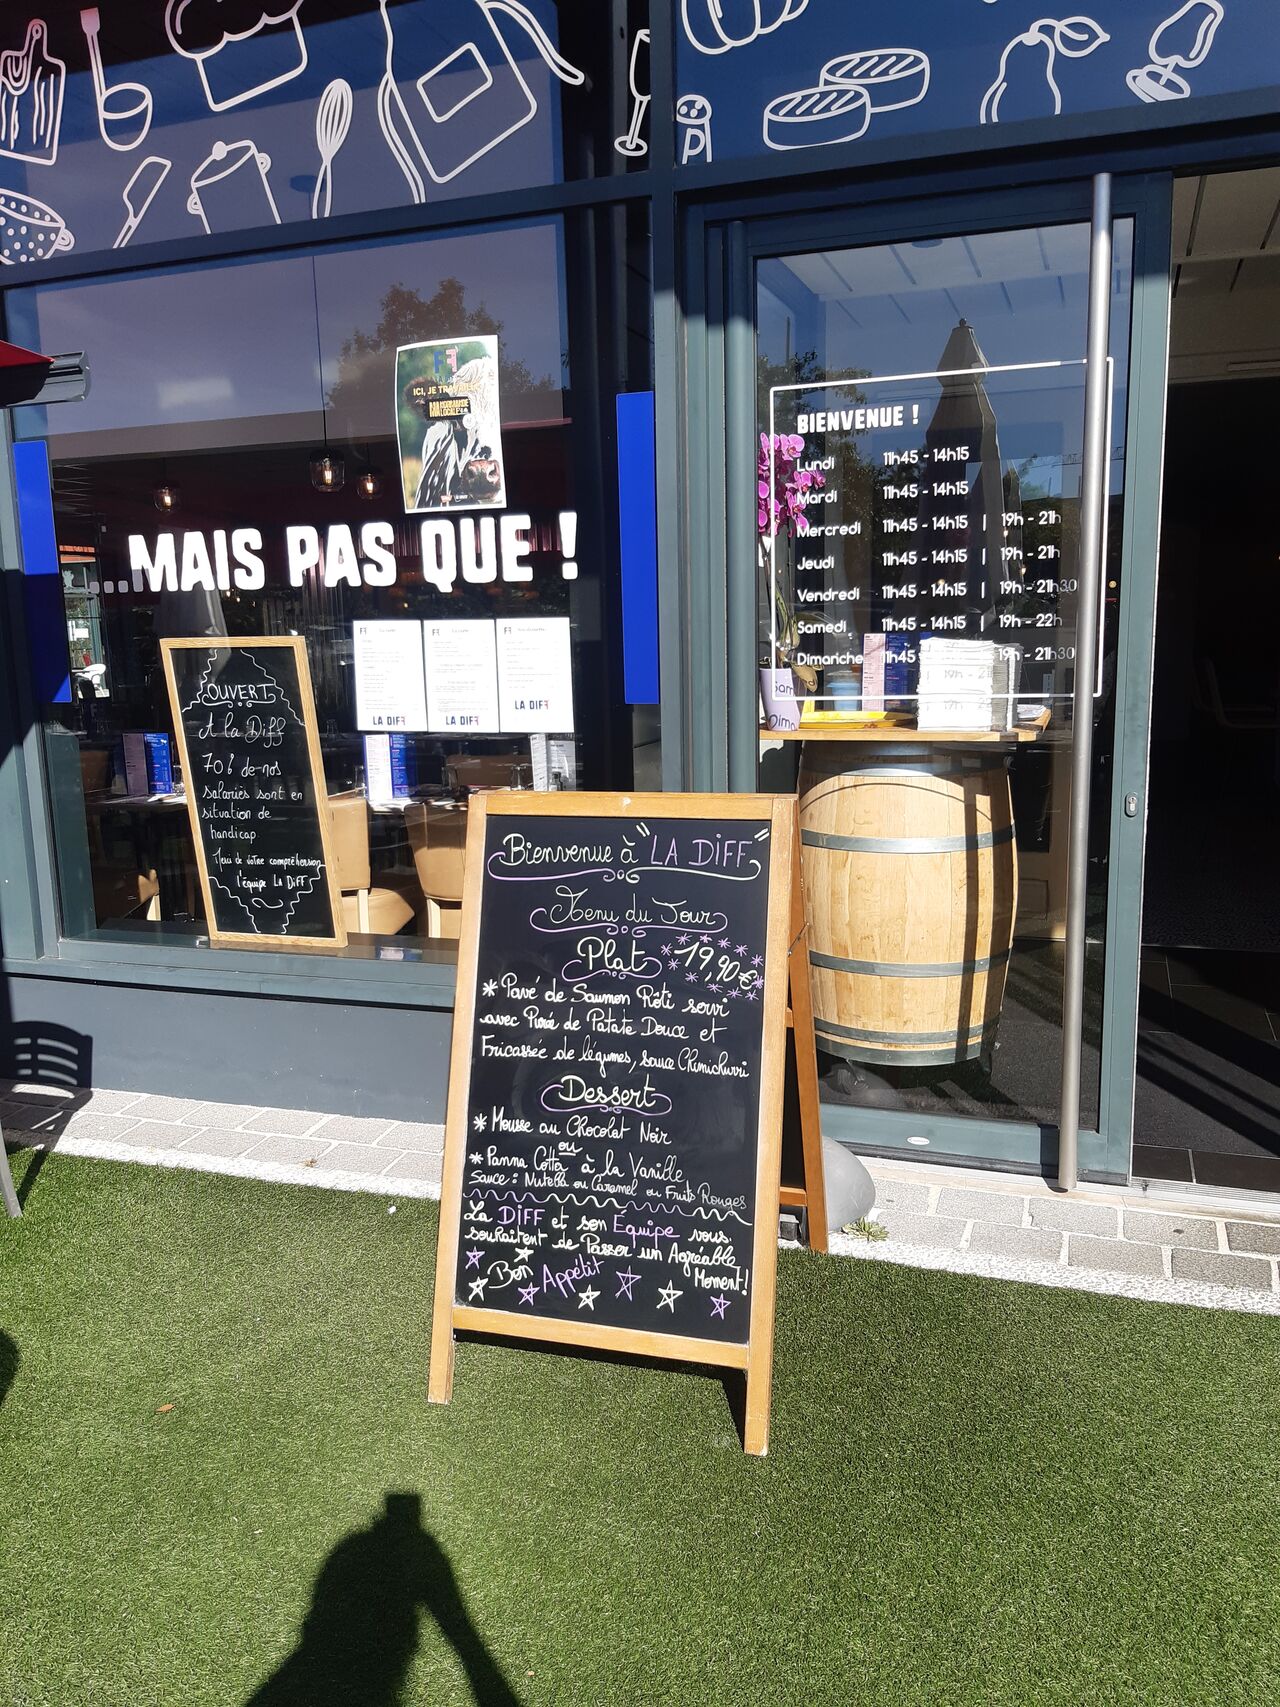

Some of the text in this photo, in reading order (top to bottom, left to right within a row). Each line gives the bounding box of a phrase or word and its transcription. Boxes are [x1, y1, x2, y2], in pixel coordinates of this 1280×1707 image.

[427, 386, 437, 395] JE
[797, 405, 919, 435] BIENVENUE !
[796, 458, 835, 472] Lundi
[883, 450, 919, 466] 11h45
[933, 446, 970, 461] 14h15
[797, 489, 838, 505] Mardi
[883, 484, 918, 500] 11h45
[932, 480, 969, 496] 14h15
[796, 522, 862, 538] Mercredi
[882, 518, 918, 534] 11h45
[931, 514, 968, 530] 14h15
[1001, 512, 1024, 527] 19h
[1038, 510, 1062, 526] 21h
[286, 522, 397, 588] PAS
[420, 514, 534, 592] QUE
[559, 512, 578, 580] !
[797, 556, 835, 572] Jeudi
[882, 550, 918, 567] 11h45
[931, 548, 968, 563] 14h15
[1000, 546, 1023, 561] 19h
[1038, 544, 1061, 559] 21h
[797, 587, 860, 603] Vendredi
[882, 583, 917, 600] 11h45
[930, 580, 967, 596] 14h15
[999, 579, 1023, 595] 19h
[1036, 579, 1077, 594] 21h30
[797, 620, 847, 636] Samedi
[881, 616, 917, 633] 11h45
[930, 614, 967, 629] 14h15
[999, 613, 1022, 628] 19h
[1036, 613, 1063, 628] 22h
[797, 651, 864, 667] Dimanche
[1035, 645, 1076, 660] 21h30
[207, 683, 275, 700] OUVERT
[515, 700, 526, 710] LA
[225, 712, 241, 738] la
[245, 715, 287, 747] Diff
[373, 716, 383, 726] LA
[445, 716, 456, 726] LA
[256, 786, 286, 800] sont
[291, 791, 303, 800] en
[202, 802, 272, 820] situation de
[210, 824, 257, 844] handicap
[235, 852, 242, 864] de
[499, 833, 614, 866] Bienvenue
[620, 835, 639, 863] à
[625, 893, 653, 923] du
[652, 897, 716, 925] Jour
[577, 936, 759, 990] Plat 19,90€
[501, 972, 730, 1017] Pavé de Saumon Rôti servi
[480, 1005, 728, 1043] avec Purée de Patate Douce et
[481, 1035, 750, 1078] Fricassée de légumes, sauce Chimichurri
[559, 1075, 657, 1108] Dessert
[491, 1106, 672, 1145] Mousse au Chocolat Noir
[558, 1140, 583, 1153] ou
[487, 1145, 686, 1183] Panna Cotta à la Vanille
[524, 1173, 570, 1188] Nutella
[573, 1180, 589, 1190] ou
[591, 1175, 638, 1196] Caramel
[646, 1188, 662, 1198] ou
[665, 1181, 697, 1203] Fruits
[697, 1182, 747, 1209] Rouges
[464, 1200, 492, 1223] La
[552, 1206, 571, 1230] et
[577, 1218, 608, 1232] son
[613, 1209, 681, 1249] Équipe
[464, 1226, 741, 1278] souhaitent de Passer un Agréable
[487, 1260, 535, 1288] Bon
[542, 1251, 605, 1299] Appétit
